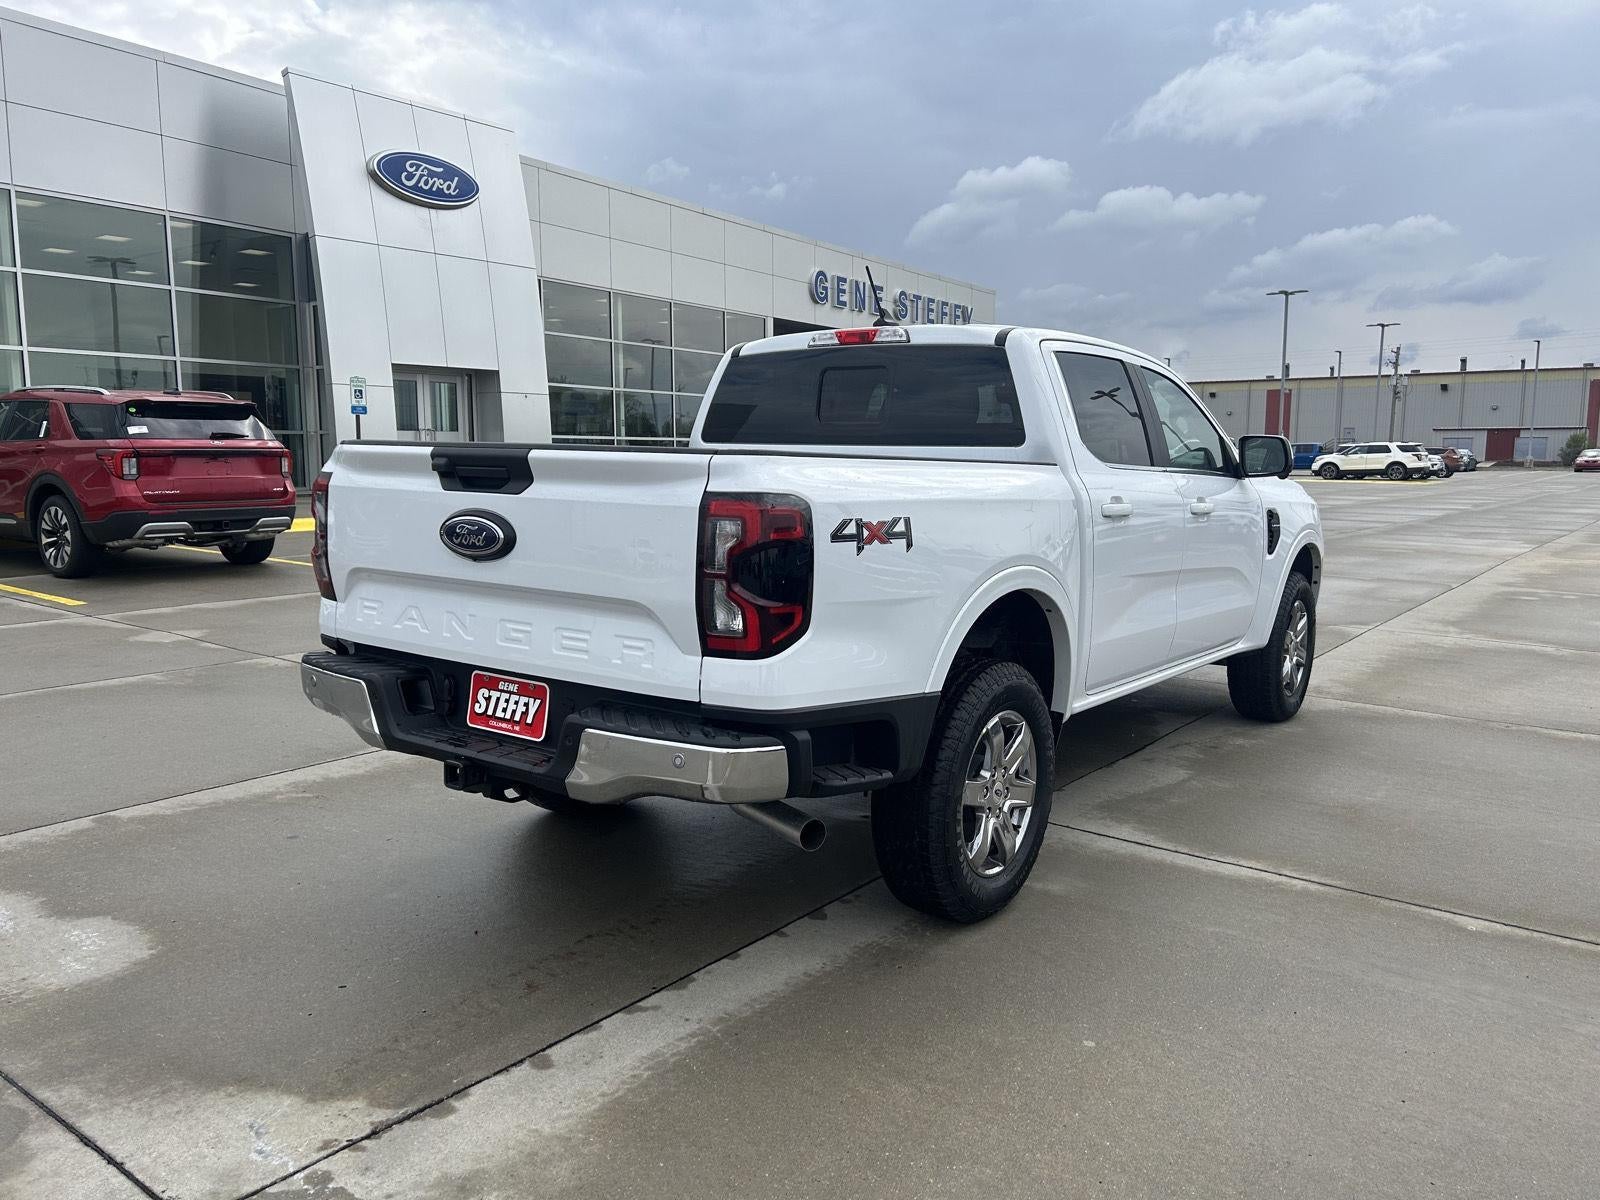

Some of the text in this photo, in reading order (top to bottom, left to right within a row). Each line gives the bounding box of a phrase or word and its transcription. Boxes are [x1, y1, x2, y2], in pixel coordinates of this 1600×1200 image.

[401, 160, 460, 195] Ford
[810, 268, 973, 325] GENE STEFFY
[453, 523, 487, 546] Ford
[352, 596, 657, 668] RANGER
[498, 681, 519, 693] GENE
[474, 687, 541, 724] STEFFY
